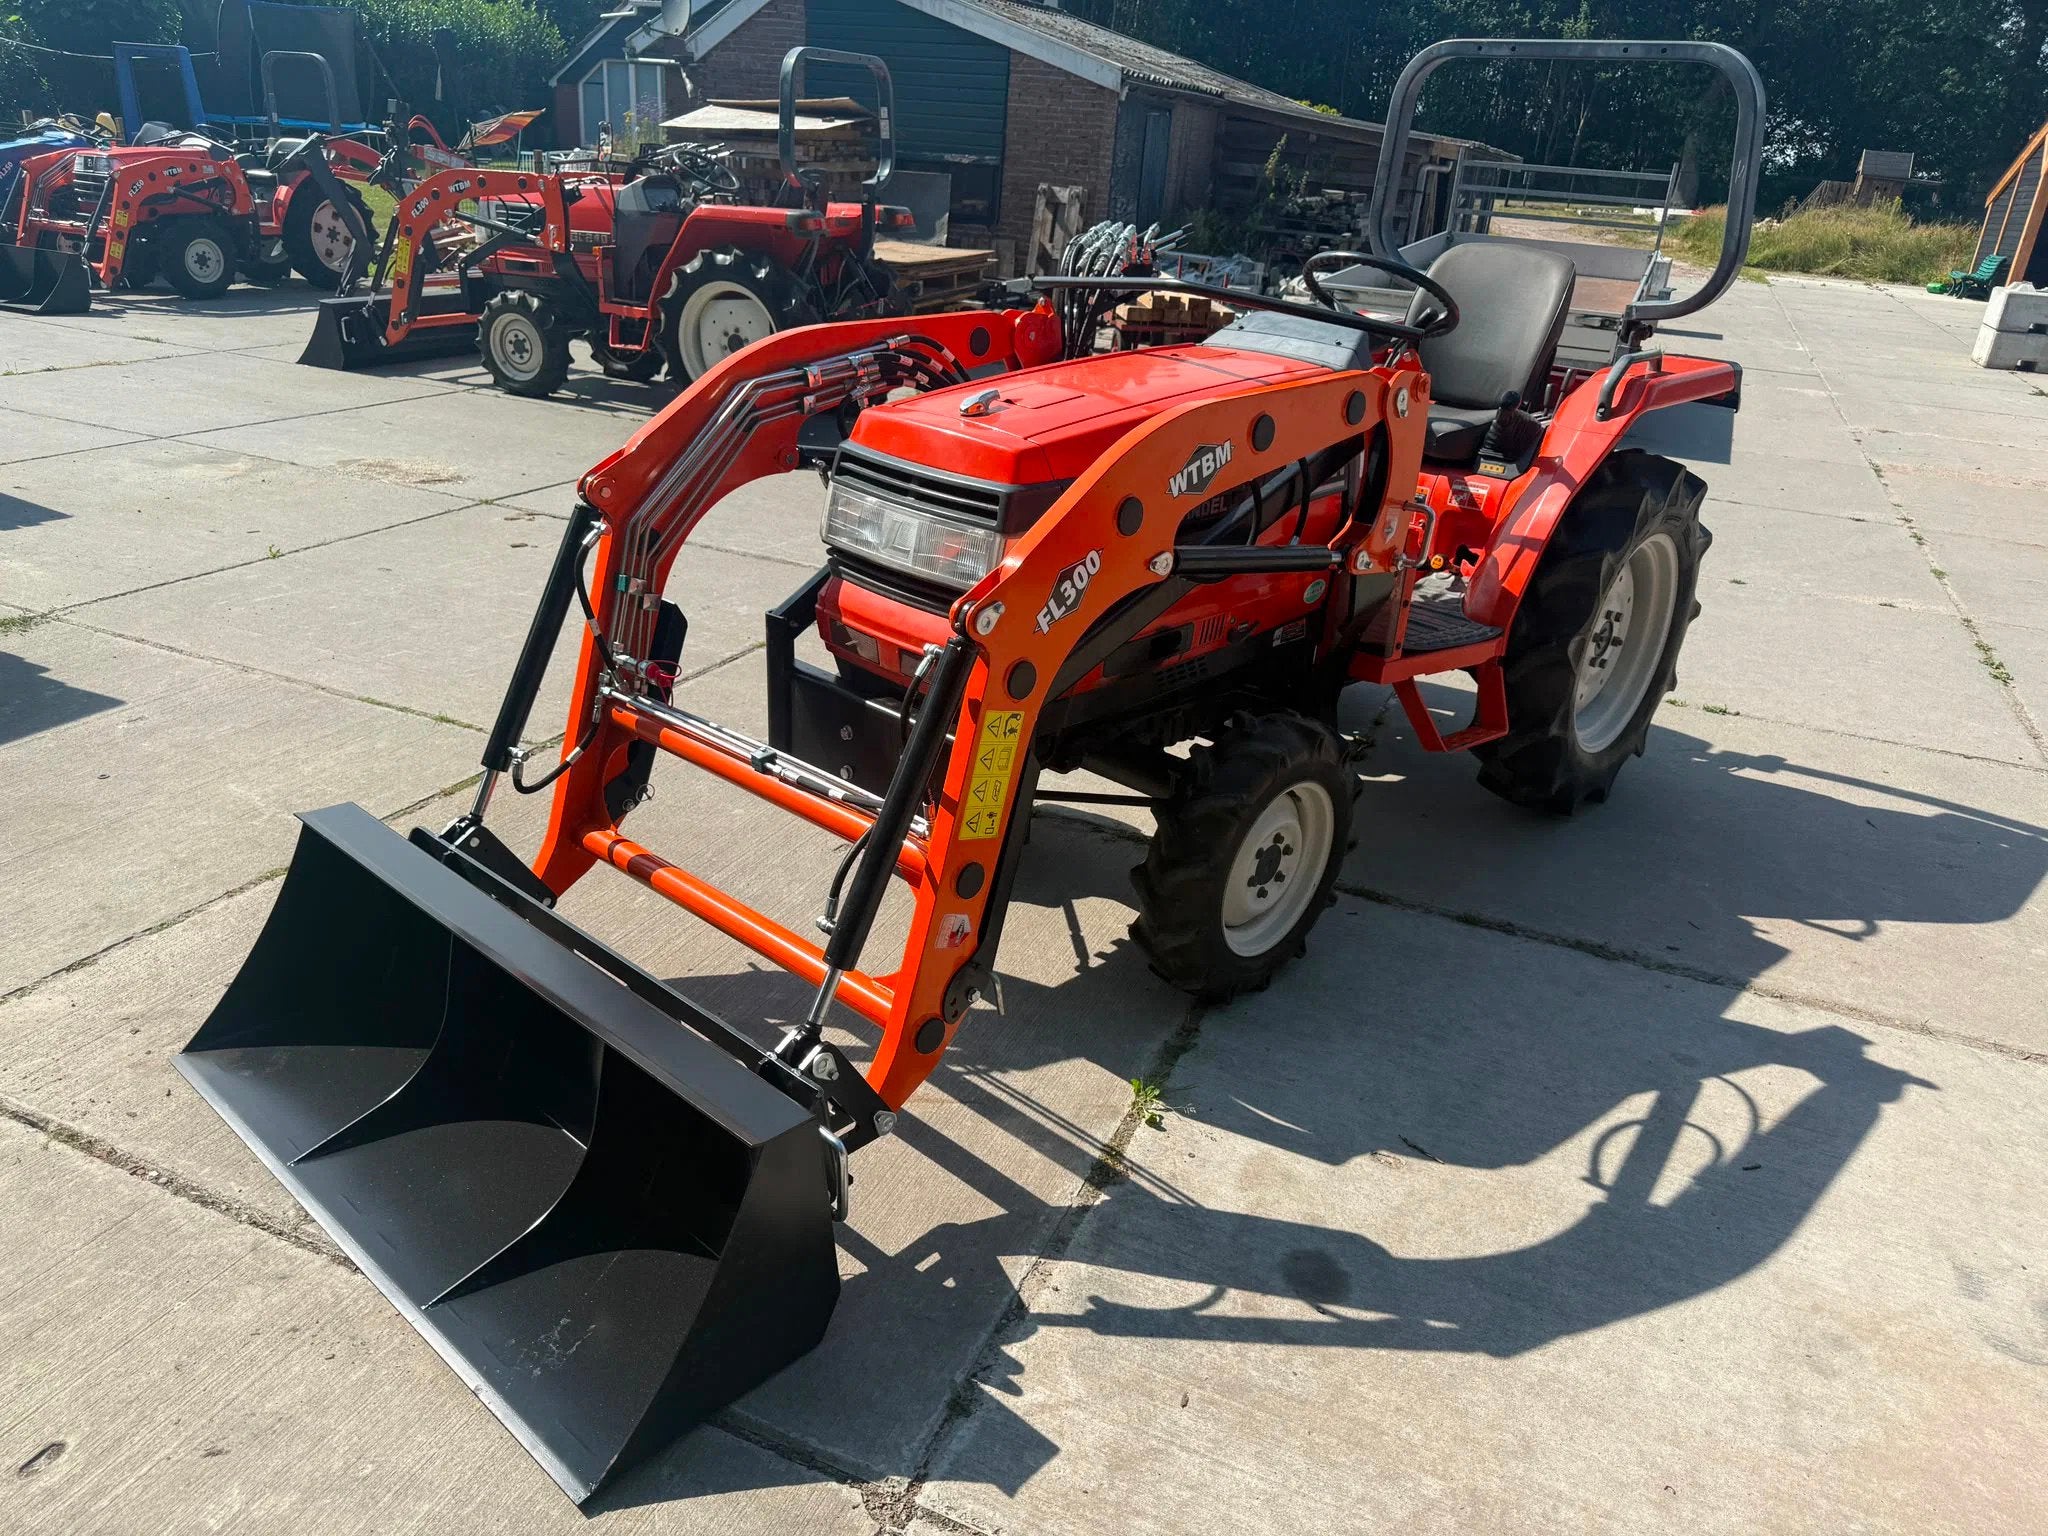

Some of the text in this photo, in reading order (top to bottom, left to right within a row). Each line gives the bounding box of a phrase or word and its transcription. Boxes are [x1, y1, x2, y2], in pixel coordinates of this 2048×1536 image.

[162, 166, 183, 177] WTBM
[448, 180, 472, 193] WTBM
[411, 197, 430, 219] FL300
[1169, 440, 1232, 499] WTBM
[1036, 549, 1102, 635] FL300
